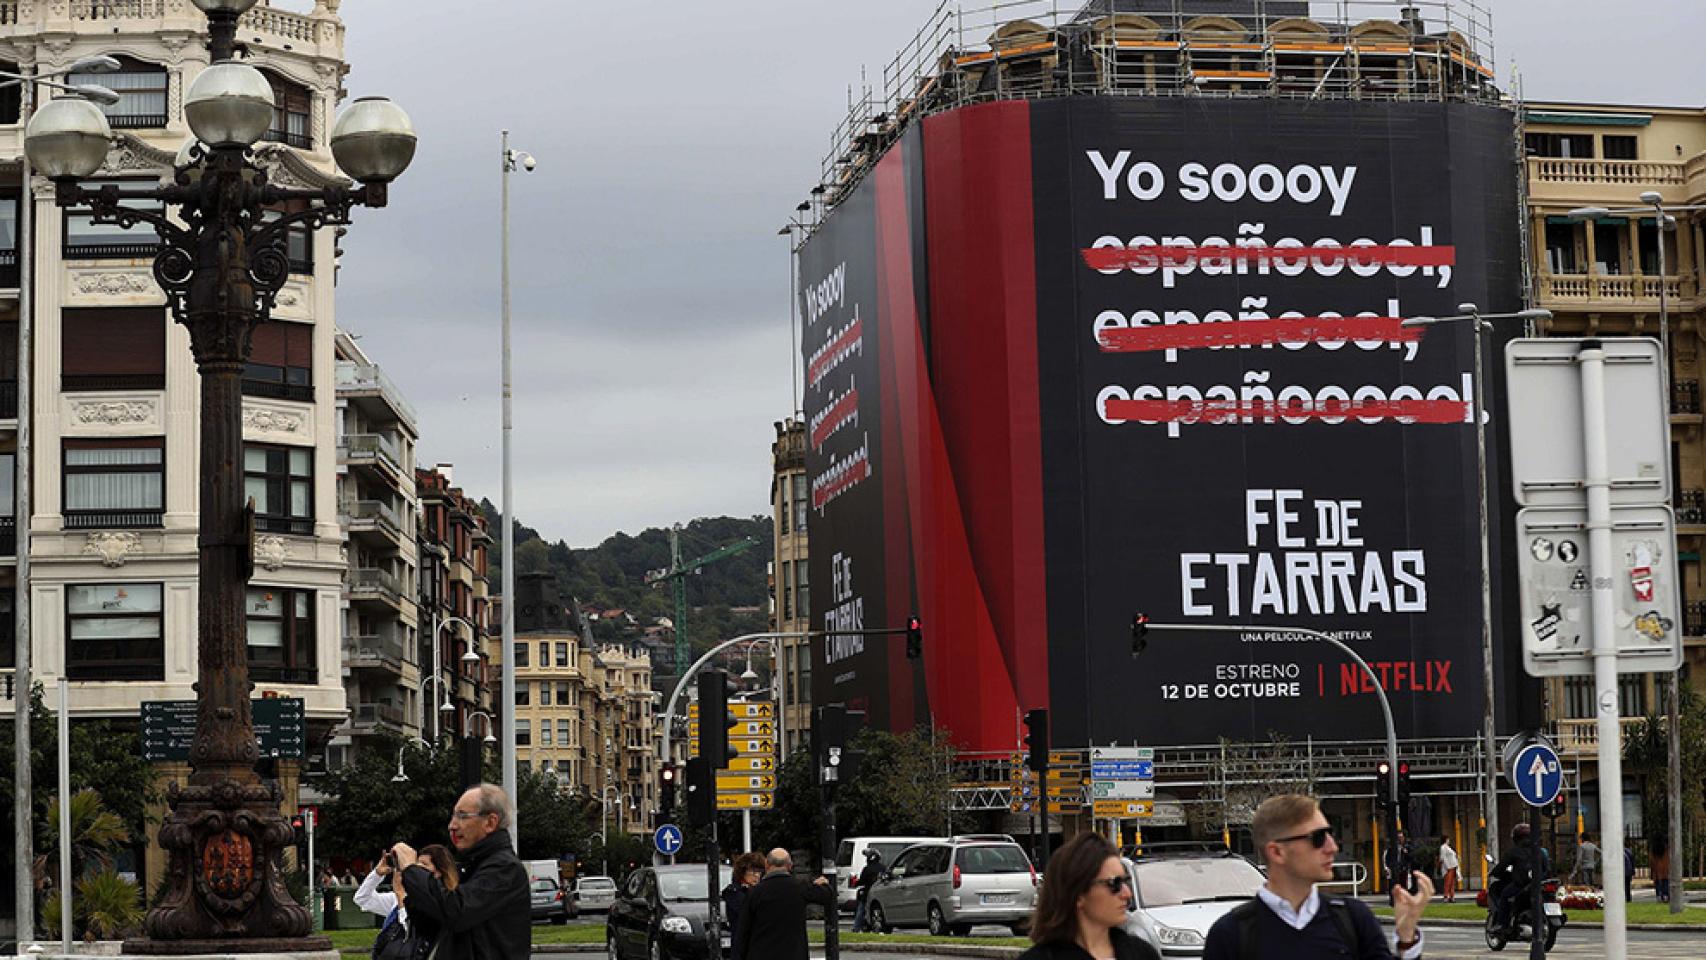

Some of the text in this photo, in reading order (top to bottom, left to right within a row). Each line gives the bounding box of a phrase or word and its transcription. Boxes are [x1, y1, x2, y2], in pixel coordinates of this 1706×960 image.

[1087, 151, 1356, 215] Yo soooy
[805, 283, 817, 327] Yo
[1246, 489, 1363, 547] FE DE
[1181, 550, 1427, 616] ETARRAS
[1240, 632, 1263, 642] UNA
[1162, 683, 1299, 698] 12 DE OCTUBRE
[1216, 664, 1300, 680] ESTRENO
[1341, 660, 1453, 696] NETFLIX
